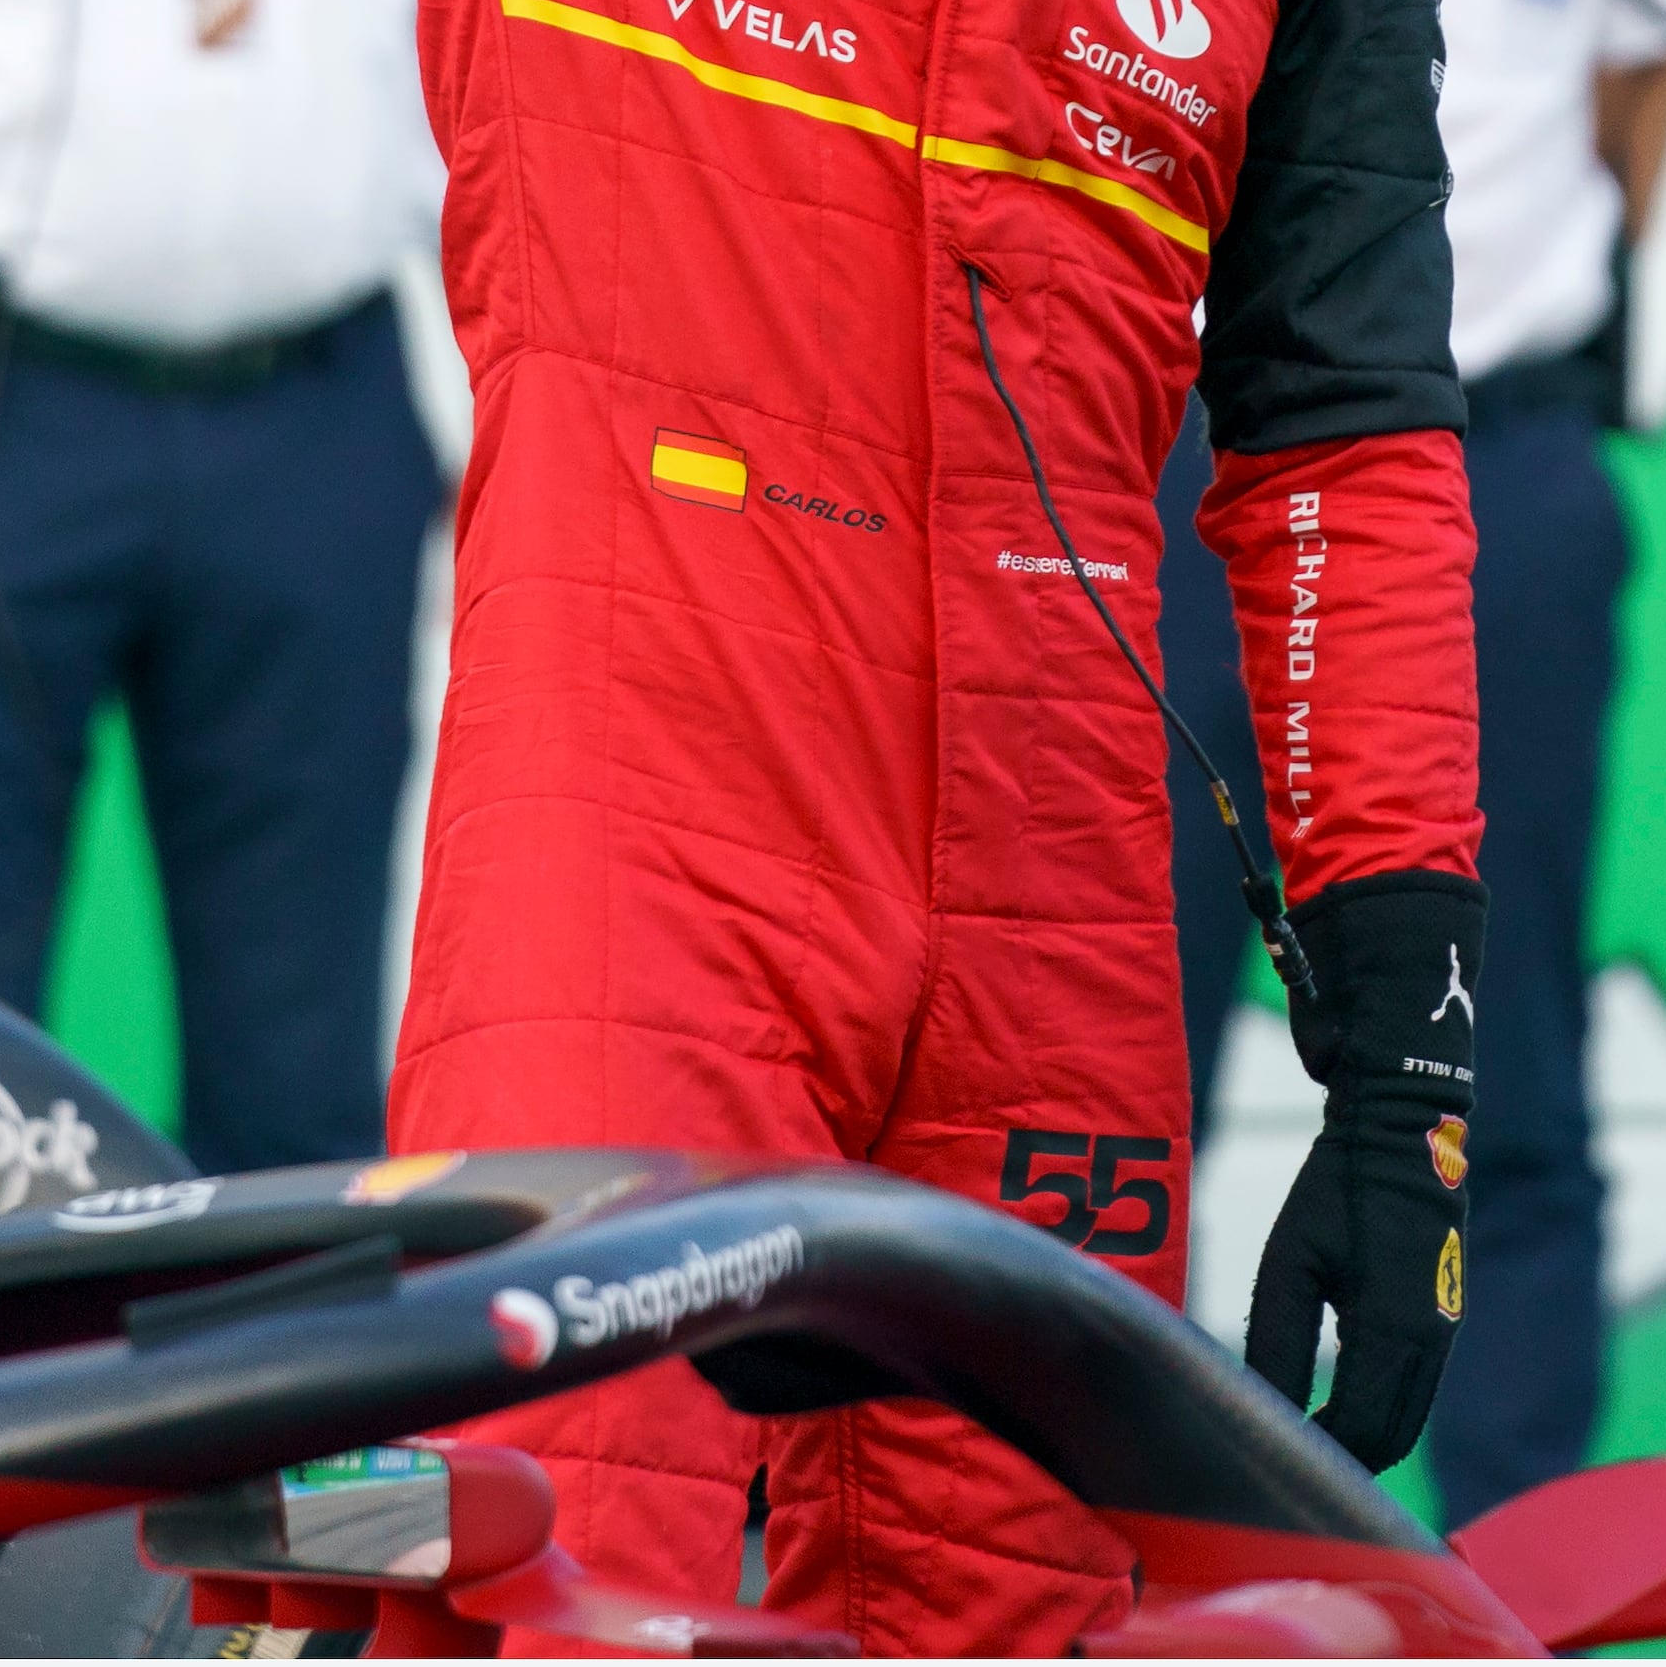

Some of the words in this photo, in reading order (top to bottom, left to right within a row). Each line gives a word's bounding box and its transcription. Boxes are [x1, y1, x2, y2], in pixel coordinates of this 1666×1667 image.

[1063, 25, 1218, 128] Santander
[763, 483, 888, 533] CARLOS
[1287, 491, 1328, 681] RICHARD
[1286, 701, 1315, 840] MILLE
[999, 1127, 1172, 1257] 55
[552, 1223, 805, 1348] Snapdragon
